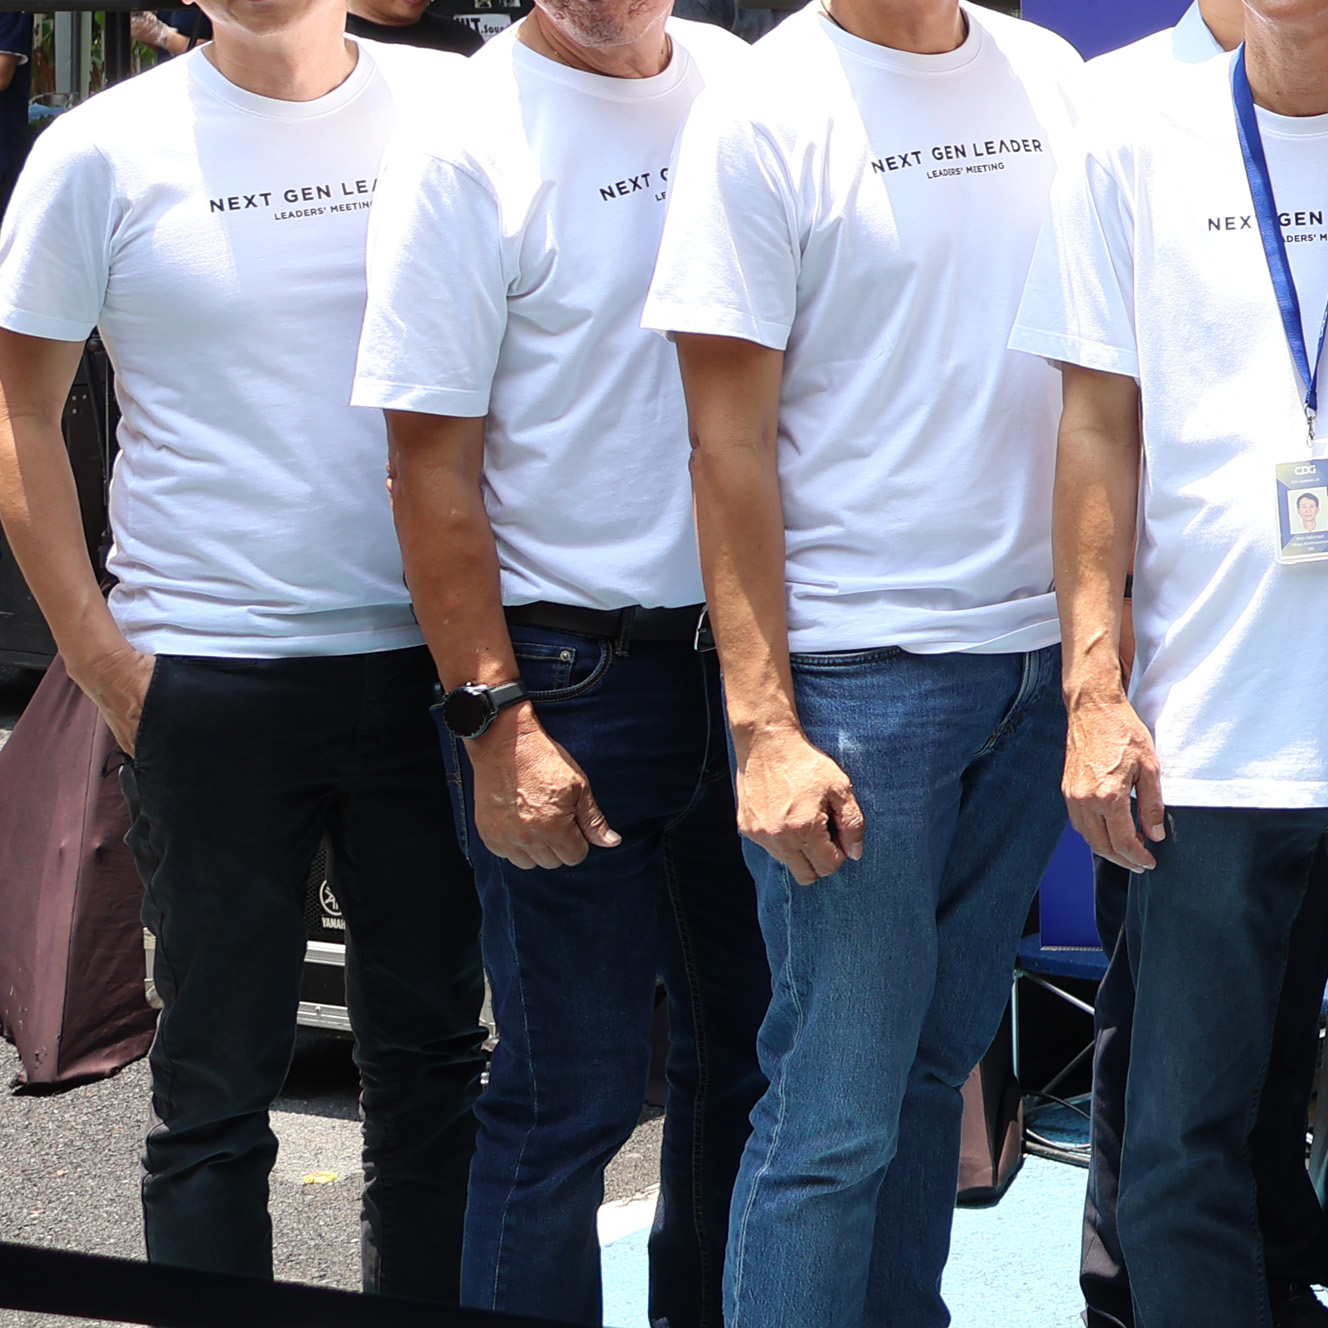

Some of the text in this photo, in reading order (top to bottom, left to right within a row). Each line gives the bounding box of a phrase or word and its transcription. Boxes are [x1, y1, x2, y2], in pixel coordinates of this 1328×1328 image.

[871, 139, 1043, 173] NEXT GEN LEADER
[927, 162, 1005, 179] LEADERS' MEETING
[599, 172, 650, 201] NEXT
[209, 192, 272, 213] NEXT
[284, 185, 331, 203] GEN
[274, 207, 326, 220] LEADERS'
[1208, 215, 1258, 231] NEX
[1279, 210, 1324, 227] GEN
[1294, 464, 1317, 476] CDG
